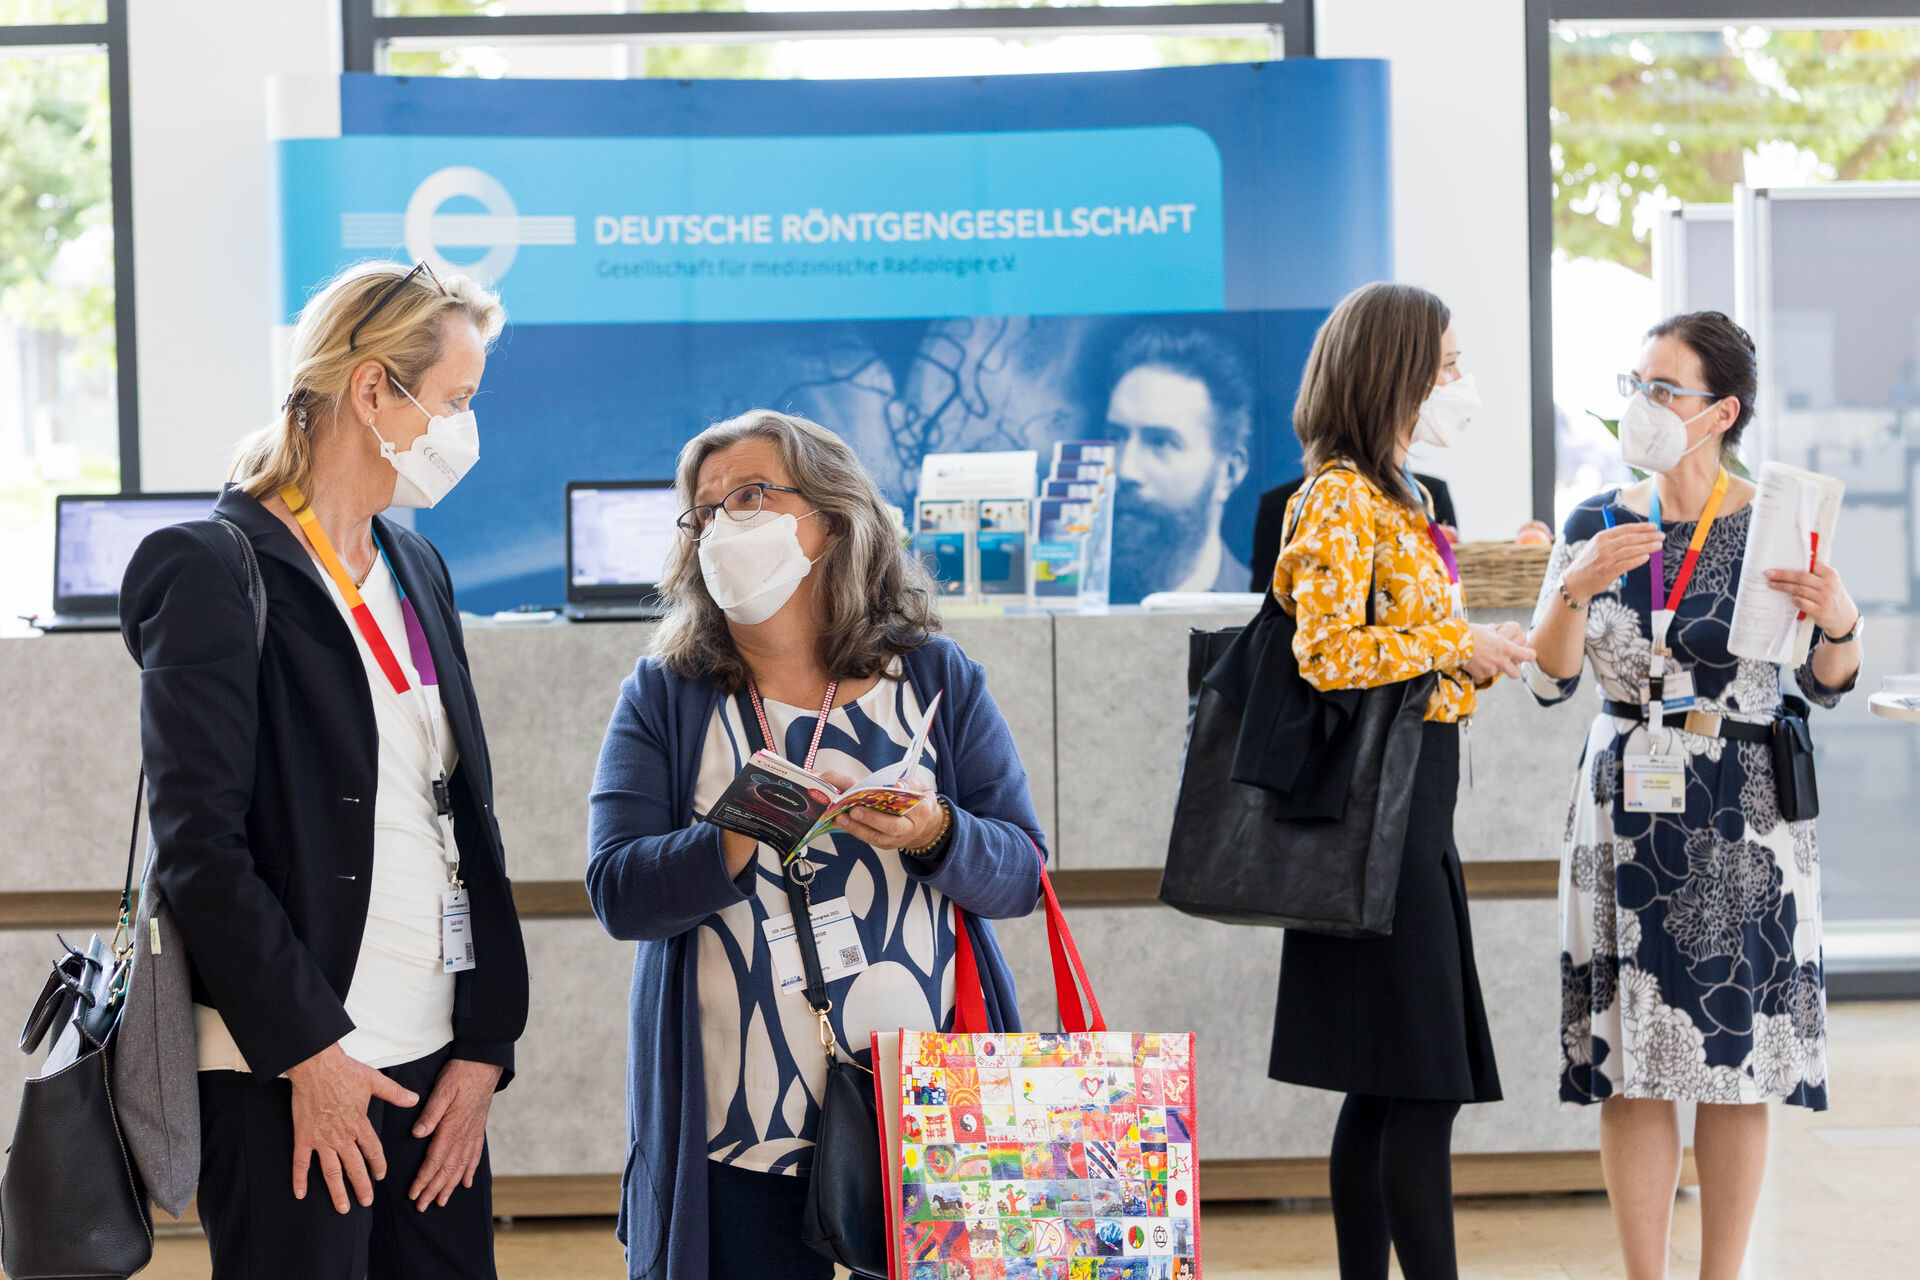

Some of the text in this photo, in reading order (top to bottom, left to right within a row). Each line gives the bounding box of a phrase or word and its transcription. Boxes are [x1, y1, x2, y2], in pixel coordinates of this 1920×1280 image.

[594, 203, 1196, 245] DEUTSCHE RÖNTGENGESELLSCHAFT
[597, 258, 716, 278] Gesellschaft
[718, 258, 747, 277] für
[752, 256, 879, 277] medizinische
[883, 254, 982, 278] Radiologie
[773, 792, 800, 806] Altivity
